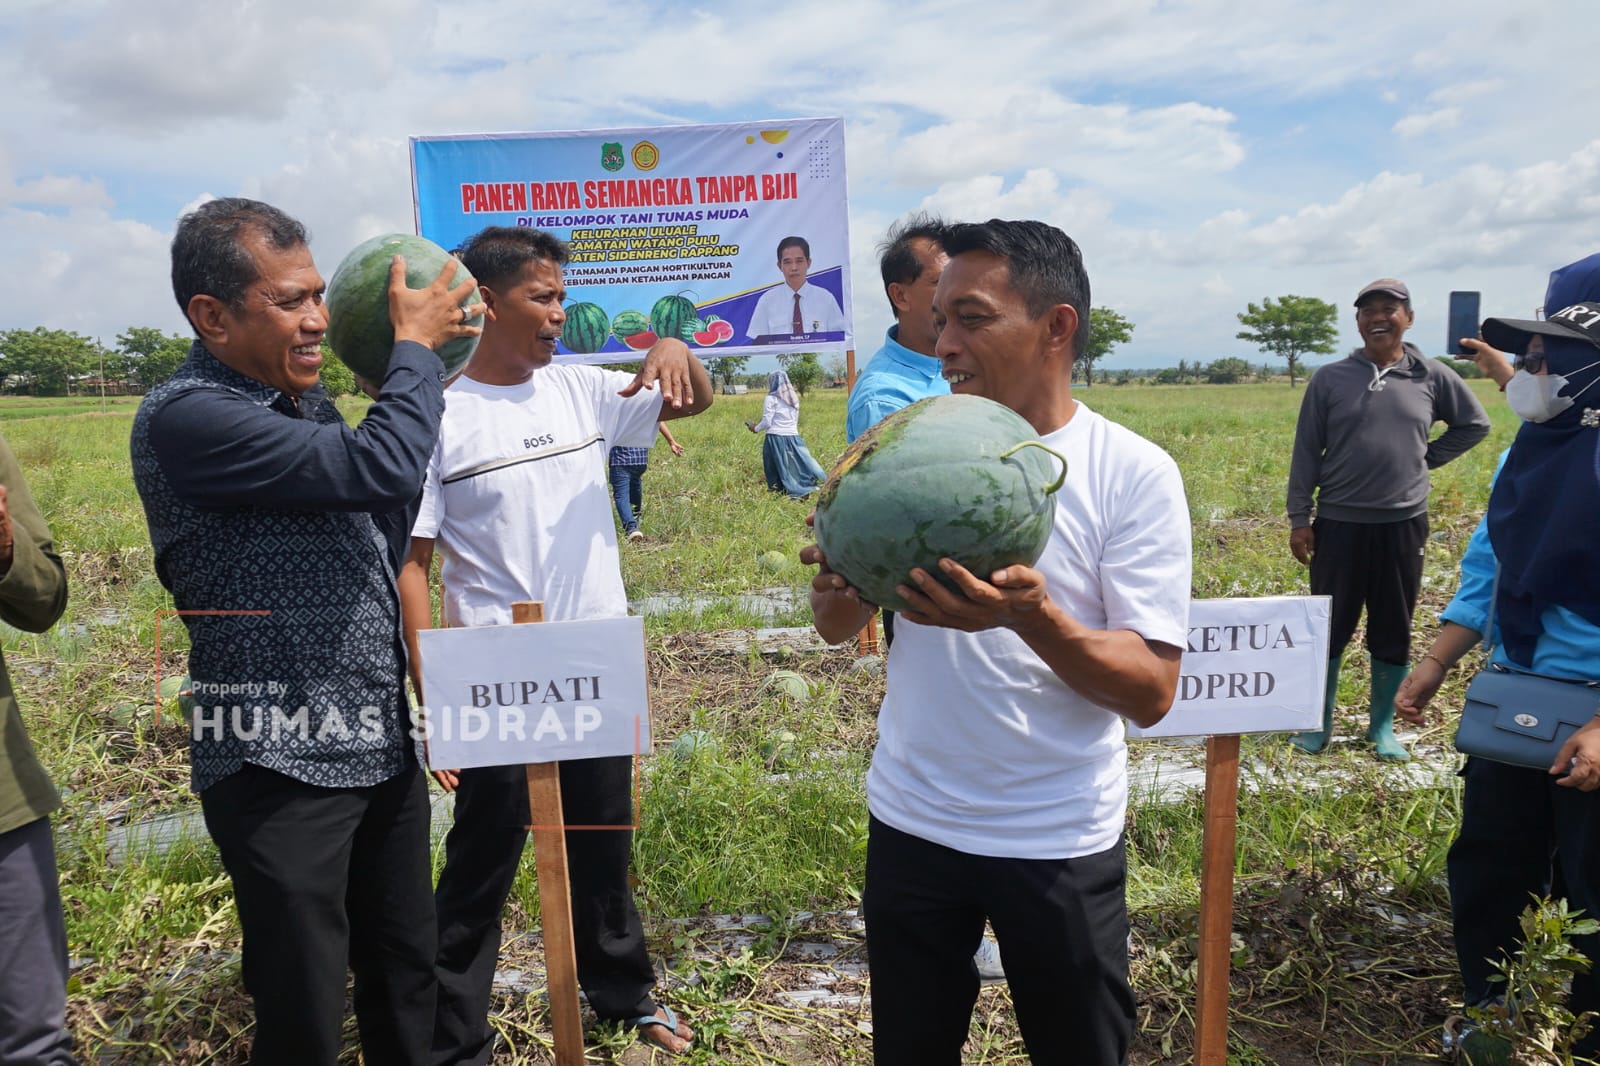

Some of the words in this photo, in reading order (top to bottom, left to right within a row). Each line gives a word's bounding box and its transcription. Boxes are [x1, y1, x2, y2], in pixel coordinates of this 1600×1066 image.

[461, 182, 527, 213] PANEN
[530, 181, 581, 211] RAYA
[584, 177, 694, 210] SEMANGKA
[696, 174, 758, 204] TANPA
[761, 172, 798, 201] BIJI
[517, 216, 532, 227] DI
[536, 214, 616, 227] KELOMPOK
[620, 213, 653, 225] TANI
[657, 210, 703, 223] TUNAS
[707, 208, 749, 221] MUDA
[572, 227, 648, 240] KELURAHAN
[650, 225, 697, 236] ULUALE
[566, 239, 628, 251] CAMATAN
[631, 237, 685, 249] WATANG
[687, 235, 719, 246] PULU
[568, 251, 606, 262] PATEN
[608, 247, 678, 261] SIDENRENG
[680, 245, 739, 258] RAPPANG
[571, 267, 618, 276] TANAMAN
[620, 265, 660, 273] PANGAN
[662, 262, 733, 272] HORTIKULTURA
[563, 277, 606, 287] KEBUNAN
[608, 276, 629, 284] DAN
[631, 273, 689, 284] KETAHANAN
[691, 271, 731, 280] PANGAN
[523, 433, 554, 449] BOSS
[469, 675, 603, 709] BUPATI
[1180, 671, 1275, 701] DPRD
